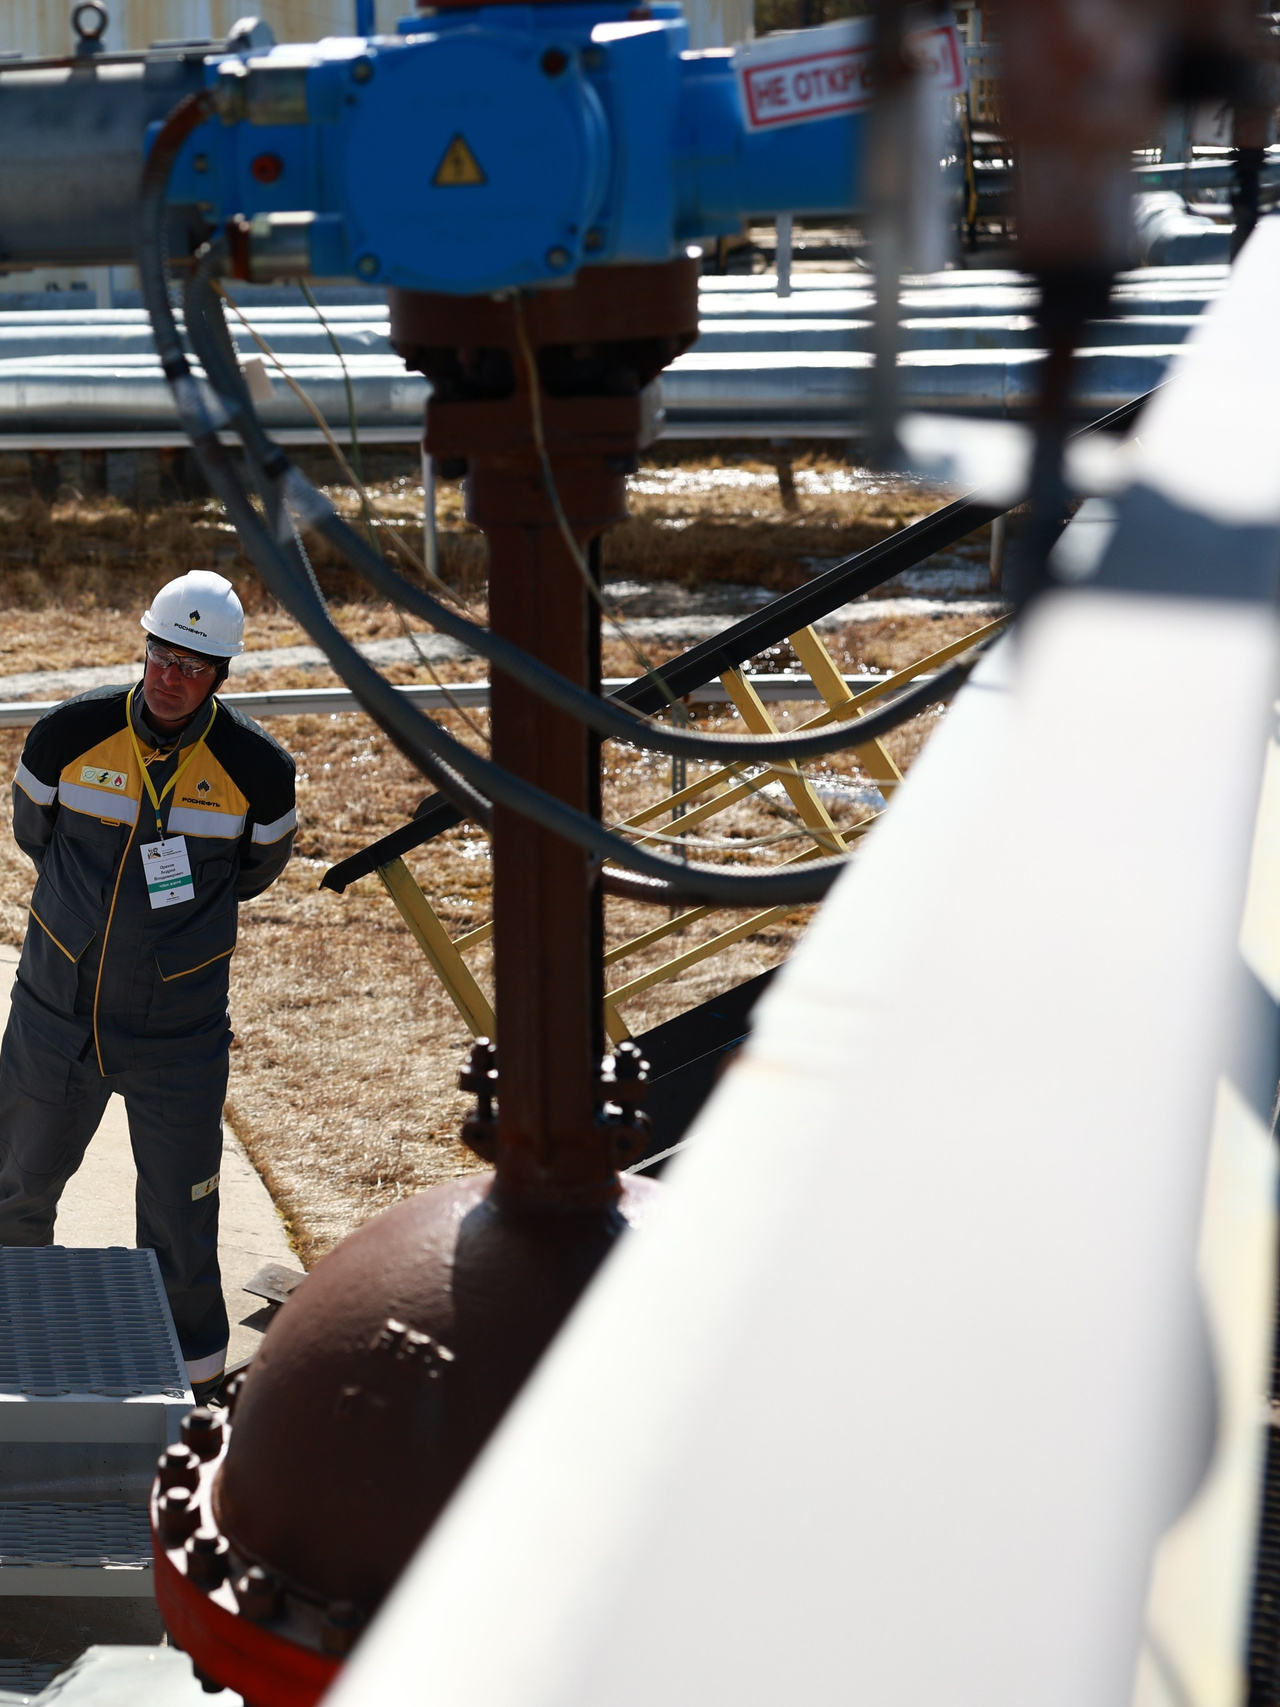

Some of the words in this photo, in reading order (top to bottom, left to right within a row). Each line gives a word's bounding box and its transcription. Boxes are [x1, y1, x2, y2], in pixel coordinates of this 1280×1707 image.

[754, 75, 788, 109] НЕ
[174, 623, 207, 637] РОСНЕФТЬ
[182, 797, 220, 807] РОСНЕФТЬ
